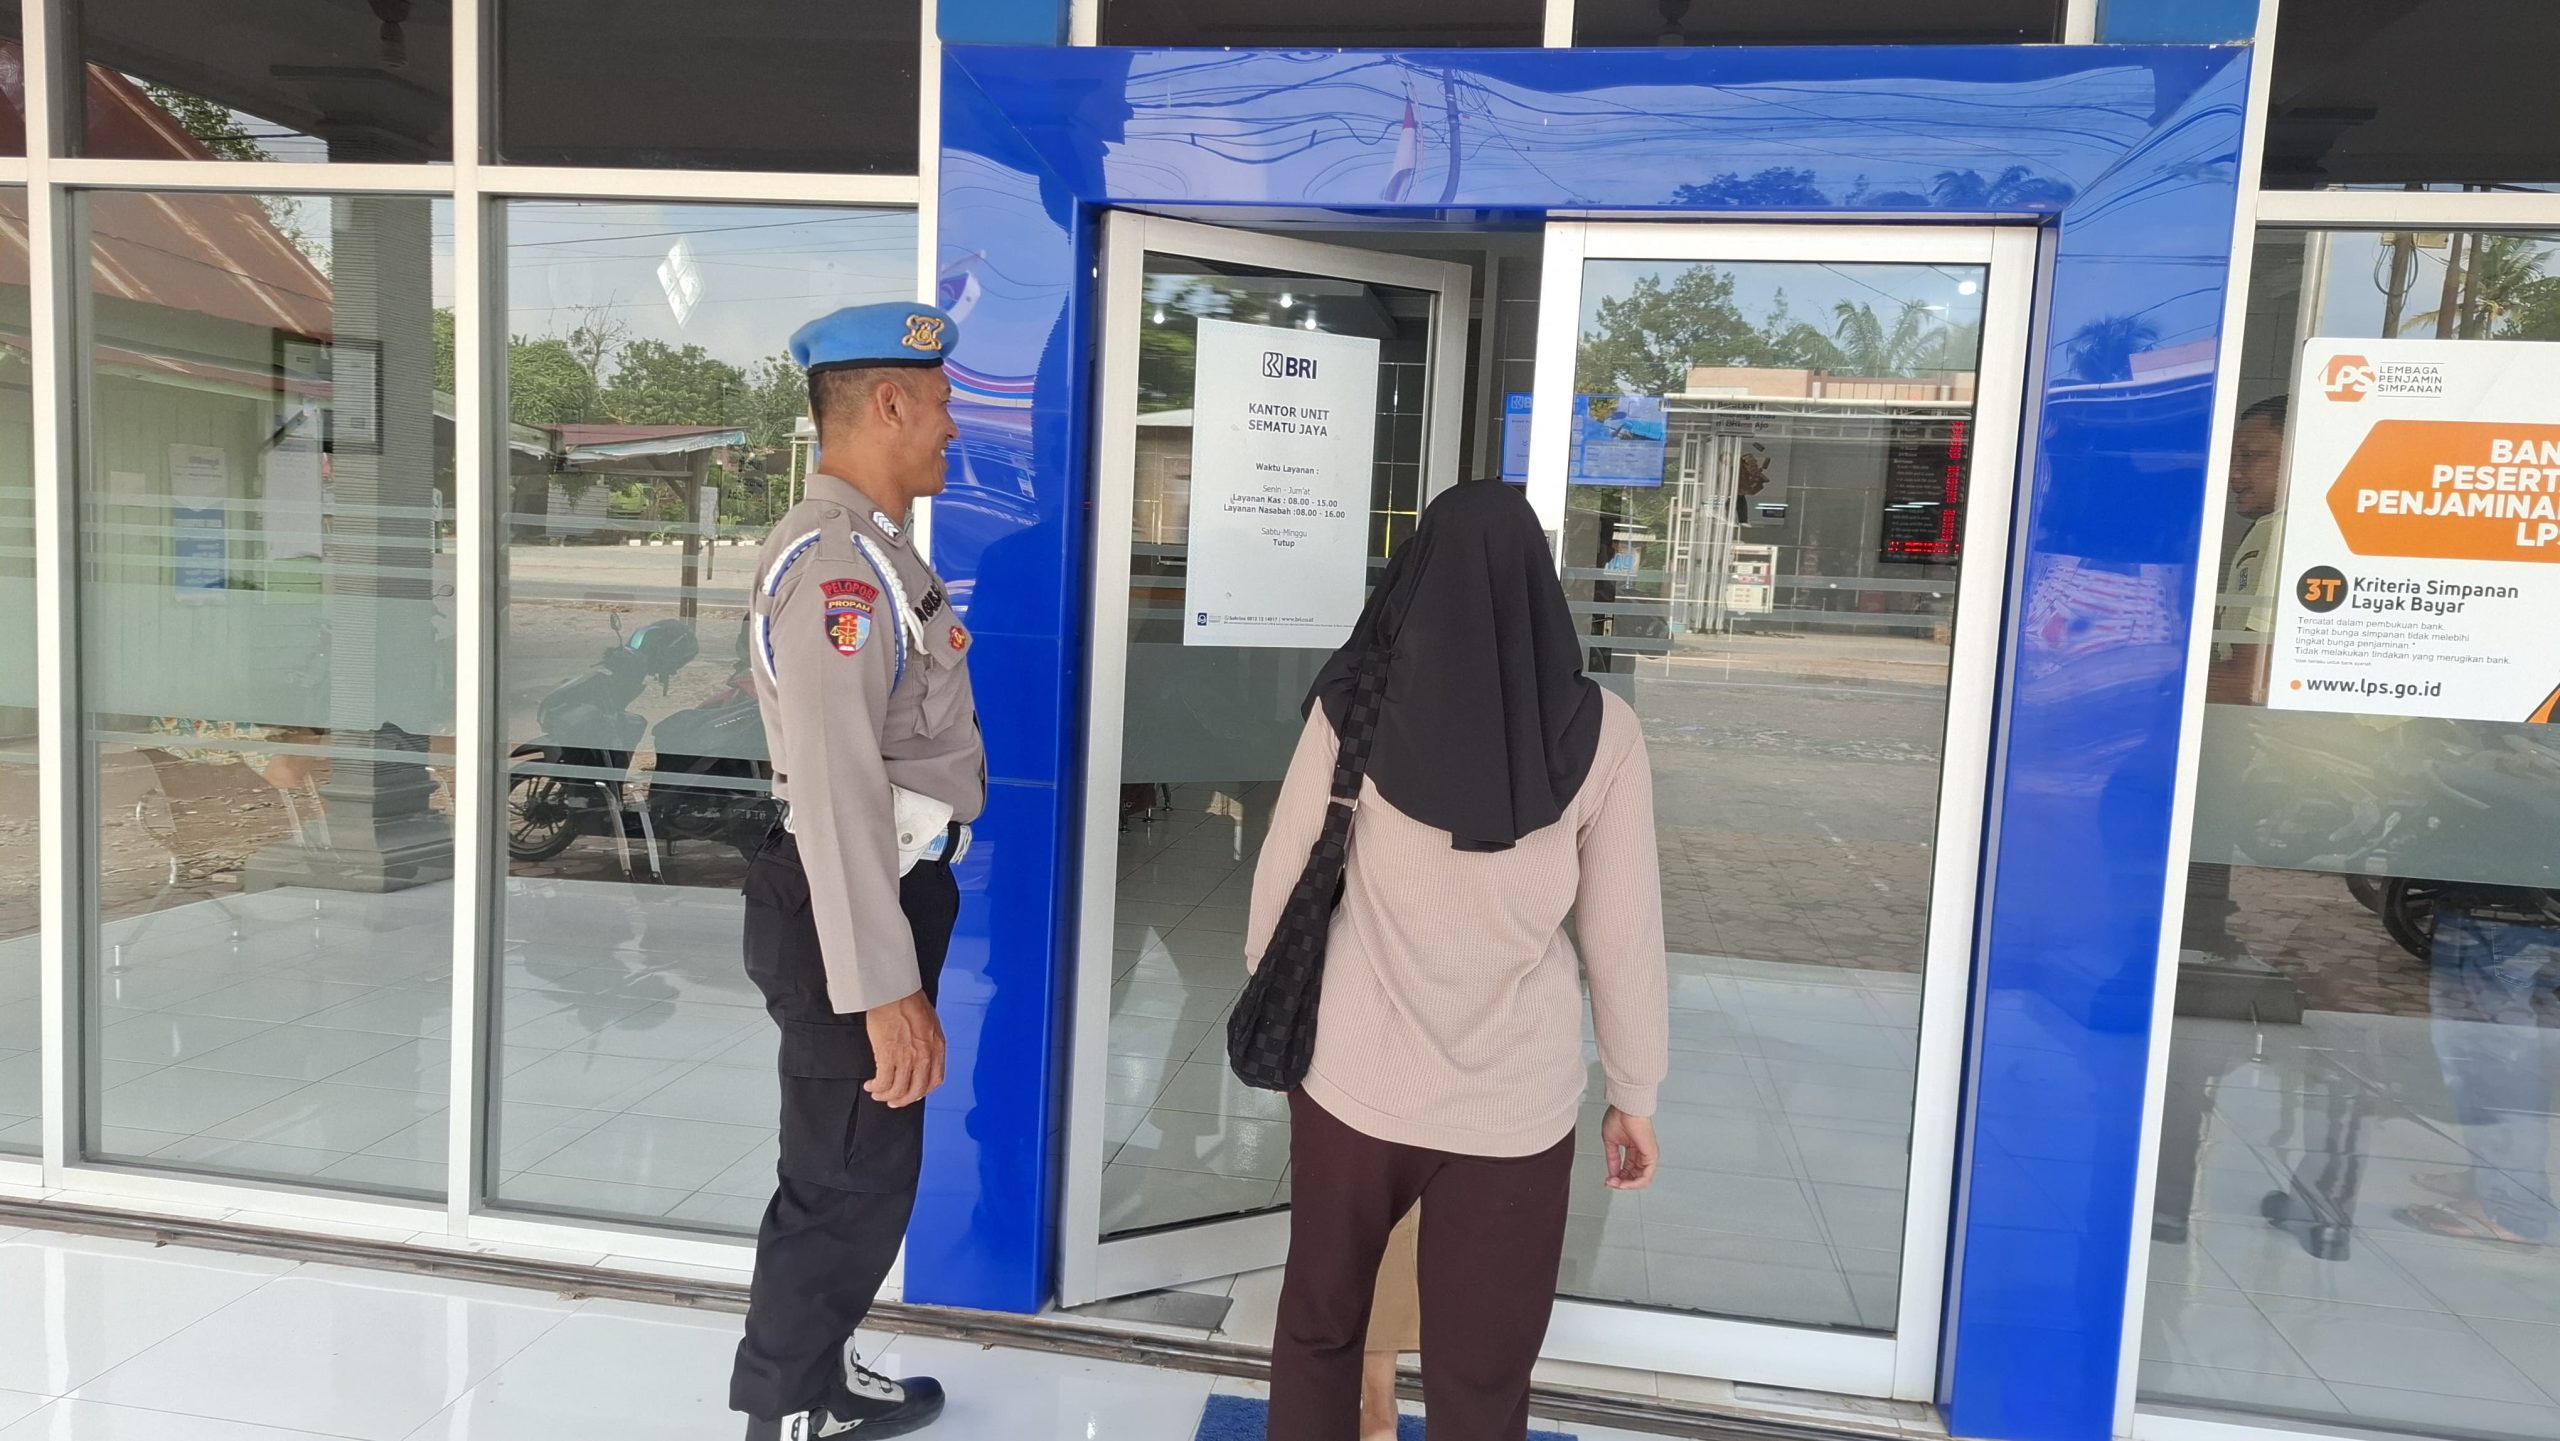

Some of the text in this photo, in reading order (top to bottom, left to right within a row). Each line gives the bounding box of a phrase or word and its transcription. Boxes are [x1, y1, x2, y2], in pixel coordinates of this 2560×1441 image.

[1286, 357, 1317, 379] BRI
[2380, 366, 2438, 375] LEMBAGA
[2379, 375, 2442, 384] PENJAMIN
[2378, 384, 2442, 393] SIMPANAN
[1248, 402, 1330, 420] KANTOR UNIT
[1248, 419, 1328, 437] SEMATU JAYA
[1256, 463, 1281, 472] Waktu
[1283, 465, 1315, 475] Layanan
[2432, 464, 2560, 493] PESERT
[1263, 485, 1281, 493] Senin
[1288, 486, 1311, 495] Jum'at
[1232, 493, 1266, 504] Layanan
[1267, 496, 1281, 504] Kas
[1288, 497, 1310, 506] 08.00
[1317, 499, 1338, 508] 15.00
[2356, 488, 2560, 521] PENJAMINA
[1223, 503, 1256, 514] Layanan
[1258, 506, 1291, 515] Nasabah
[1324, 510, 1346, 519] 16.00
[1273, 538, 1295, 548] Tutup
[2516, 521, 2560, 548] LP
[824, 580, 874, 599] PELOPOR
[2304, 578, 2342, 602] 3T
[2353, 576, 2519, 600] Kriteria Simpanan
[828, 600, 871, 612] PROPAM
[2352, 594, 2465, 617] Layak Bayar
[2298, 616, 2446, 630] Tercatat dalam pembukuan bank.
[2295, 636, 2325, 646] tingkat
[2327, 638, 2355, 648] bunga
[2297, 626, 2470, 642] Tingkat bunga simpanan tidak melebihi
[2294, 646, 2511, 665] Tidak melakukan tindakan yang merugikan bank.
[2306, 678, 2442, 699] www.lps.go.id
